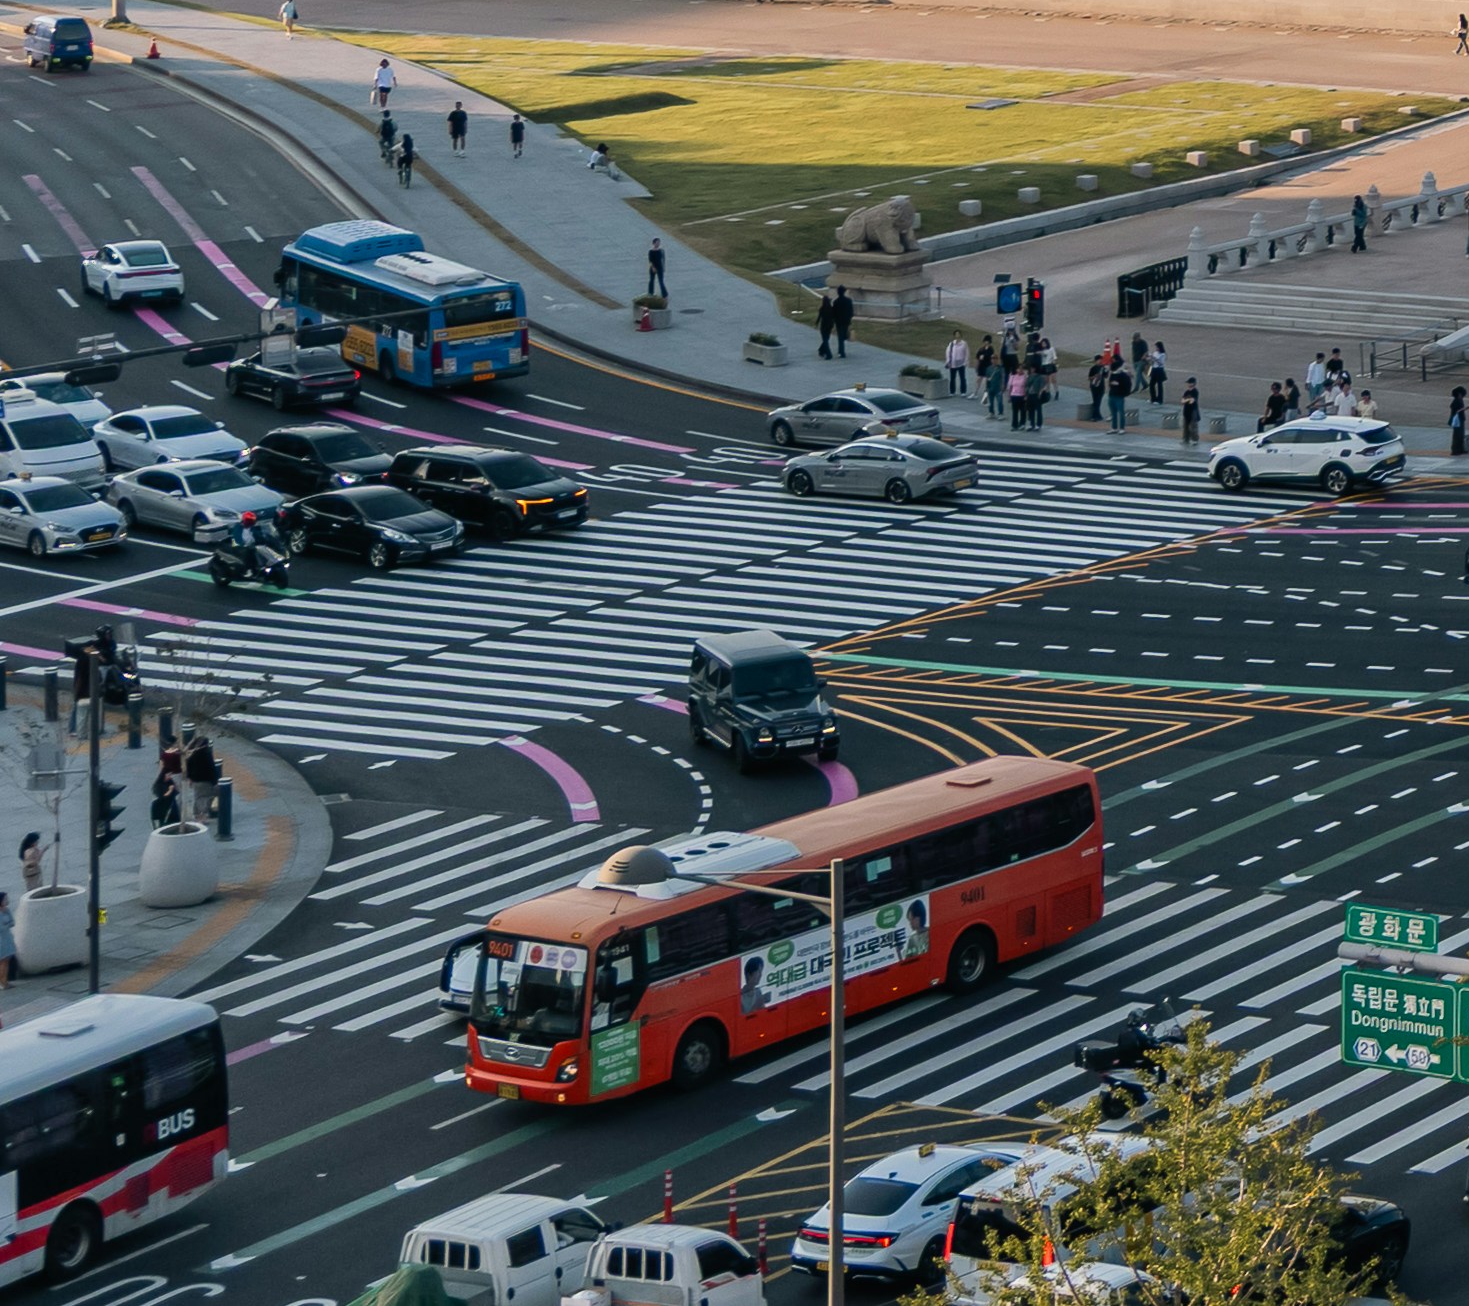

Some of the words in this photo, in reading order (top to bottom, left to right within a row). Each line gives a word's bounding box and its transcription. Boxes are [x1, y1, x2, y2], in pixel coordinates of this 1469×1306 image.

[495, 300, 513, 312] 272
[960, 886, 985, 907] 9401
[1358, 911, 1426, 945] 광화문
[488, 940, 514, 958] 9401
[766, 961, 807, 988] 역대급
[854, 930, 905, 959] 프로젝트
[1352, 983, 1399, 1013] 독립문
[1403, 993, 1445, 1020] 獨立門
[1351, 1010, 1444, 1037] Dongnimmun
[1359, 1042, 1377, 1057] 21
